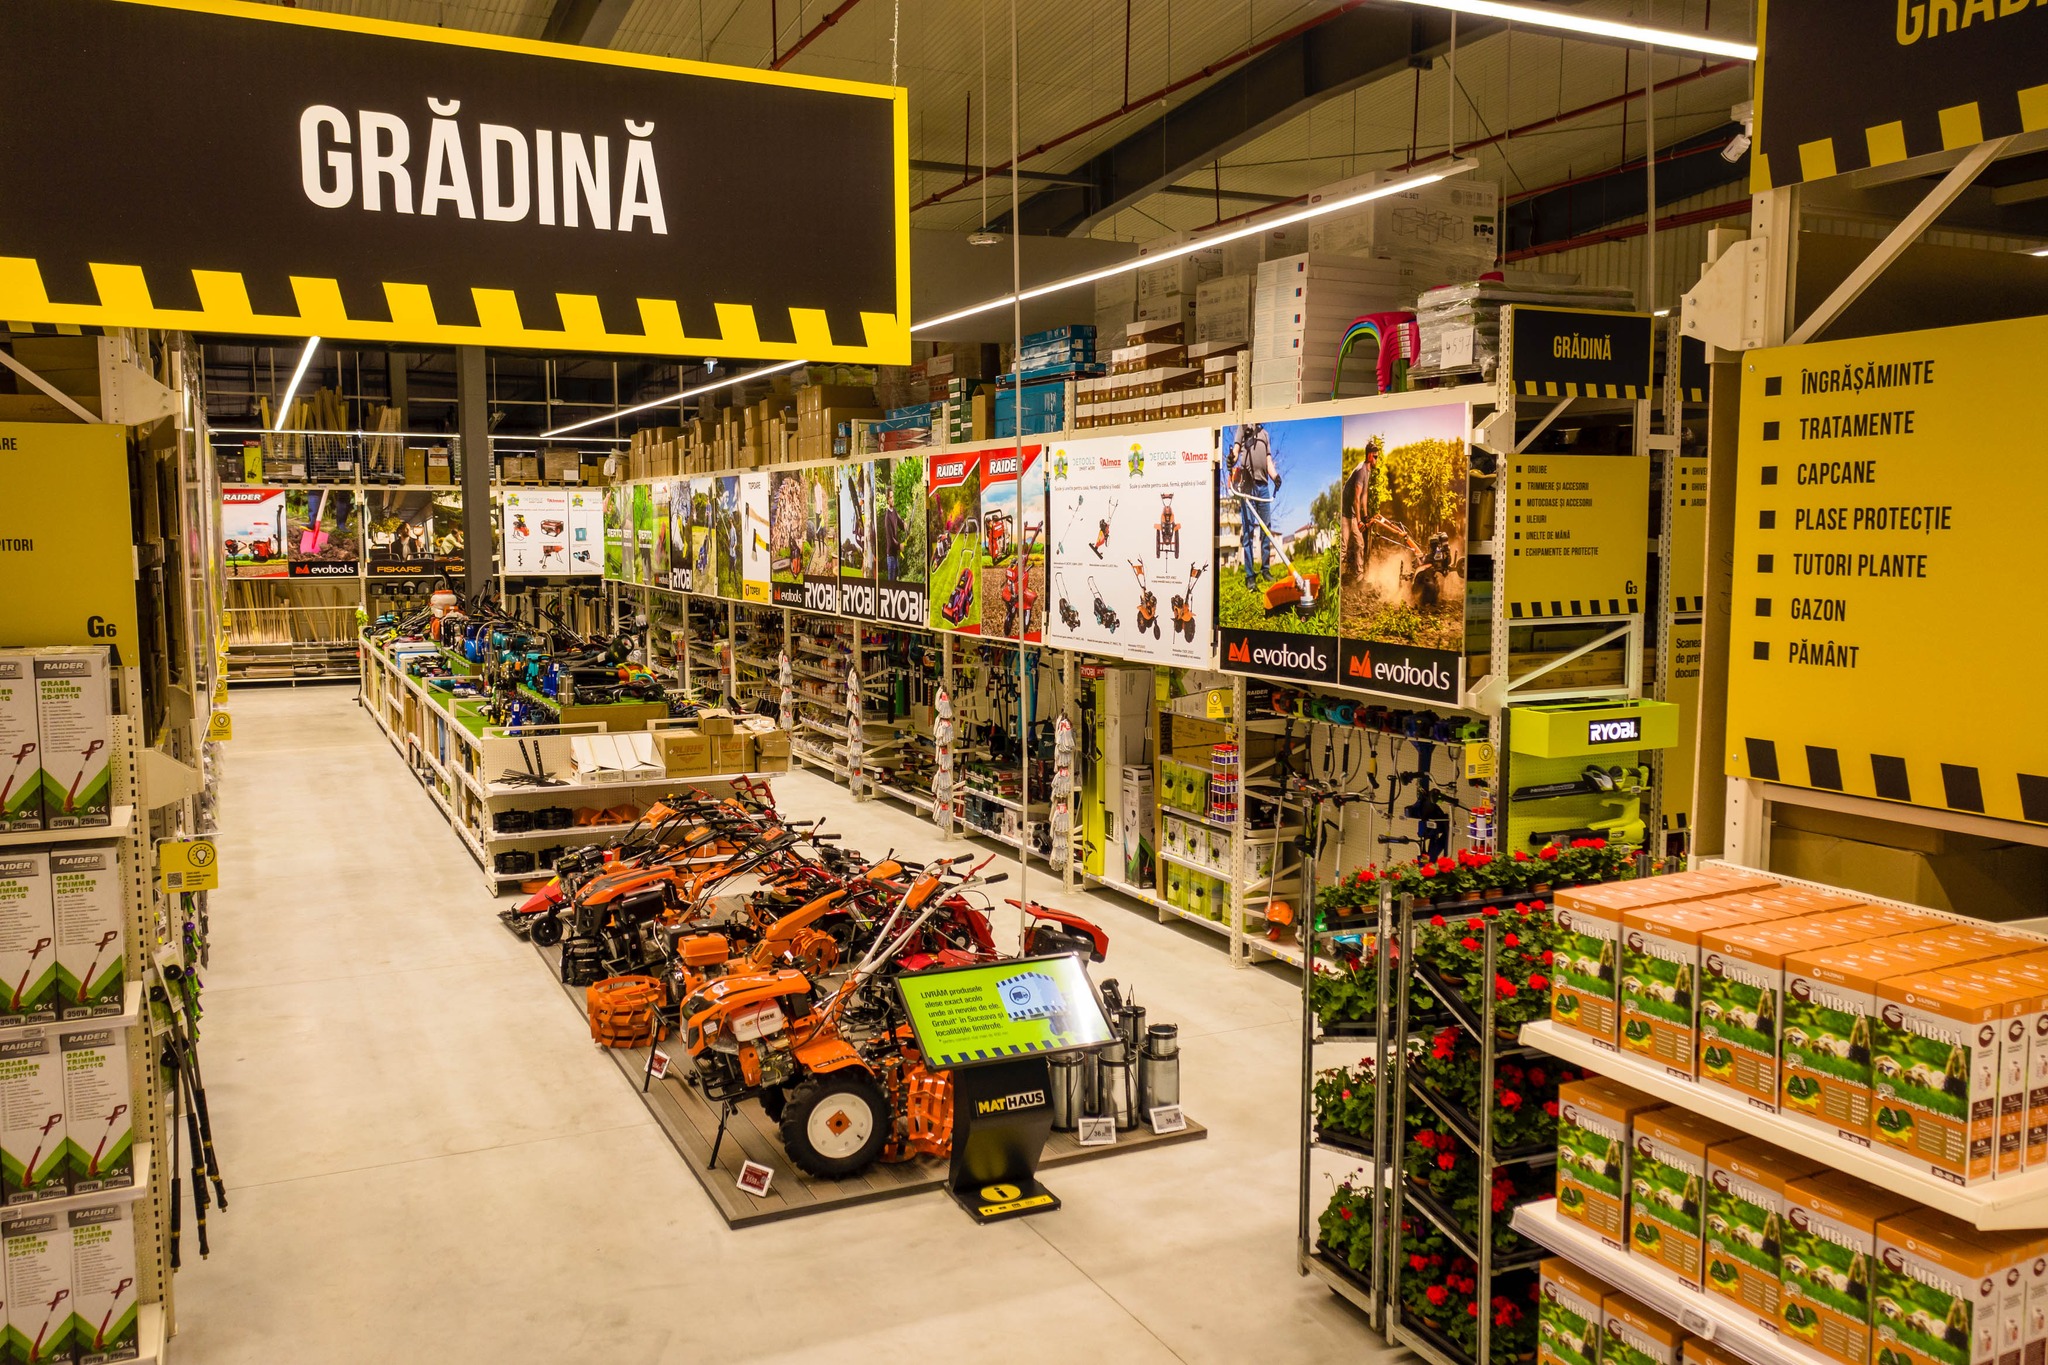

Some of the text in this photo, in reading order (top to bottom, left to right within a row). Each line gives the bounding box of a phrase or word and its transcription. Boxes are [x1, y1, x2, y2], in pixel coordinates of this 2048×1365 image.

[299, 97, 668, 235] GRĂDINĂ
[1553, 332, 1612, 361] GRĂDINĂ
[1801, 359, 1935, 395] ÎNGRĂȘĂMINTE
[1800, 410, 1915, 440] TRATAMENTE
[0, 437, 17, 450] RE
[1185, 451, 1208, 461] Almaz
[937, 461, 964, 478] RAIDER
[1528, 465, 1548, 474] DRUJBE
[1797, 460, 1877, 486] CAPCANE
[1527, 482, 1555, 490] TRIMMERE
[1562, 482, 1589, 490] ACCESORII
[223, 493, 261, 501] RAIDER
[1527, 498, 1559, 507] MOTOCOASE
[1566, 498, 1593, 507] ACCESORII
[1526, 515, 1547, 523] ULEIURI
[1795, 506, 1952, 536] PLASE PROTECȚIE
[1526, 532, 1546, 540] UNELTE
[1526, 548, 1562, 556] ECHIPAMENTE
[1571, 547, 1599, 557] PROTECȚIE
[312, 564, 354, 574] evotools
[1793, 553, 1928, 578] TUTORI PLANTE
[780, 590, 802, 603] evotools
[804, 582, 836, 612] RYOBI
[842, 584, 875, 616] RYOBI
[880, 587, 924, 622] RYOBI
[1791, 597, 1846, 622] GAZON
[87, 615, 117, 638] G6
[1253, 643, 1327, 672] evotools
[1675, 653, 1685, 664] de
[1789, 638, 1859, 668] PĂMÂNT
[43, 662, 84, 671] RAIDER
[1375, 658, 1450, 690] evotools
[12, 822, 39, 830] 250mm
[53, 817, 107, 827] 350W 250mm
[59, 856, 99, 865] RAIDER
[0, 862, 31, 871] AIDER
[56, 874, 86, 882] GRASS
[56, 880, 97, 888] TRIMMER
[921, 986, 982, 999] LIVRĂM produsele
[925, 995, 983, 1008] alese exact acolo
[66, 1007, 120, 1018] 350W 250mm
[928, 1009, 946, 1018] unde
[955, 1005, 978, 1014] nevoie
[28, 1015, 55, 1023] 250mm
[967, 1013, 997, 1022] Suceava
[68, 1032, 108, 1043] RAIDER
[1, 1041, 42, 1051] RAIDER
[66, 1050, 95, 1059] GRASS
[66, 1055, 106, 1066] TRIMMER
[0, 1064, 40, 1074] TRIMMER
[978, 1092, 1045, 1114] MATHAUS
[78, 1178, 130, 1192] 350W 250mm
[39, 1189, 66, 1199] 250mm
[75, 1207, 114, 1219] RAIDER
[10, 1217, 50, 1229] RAIDER
[73, 1230, 113, 1241] TRIMMER
[8, 1241, 48, 1252] TRIMMER
